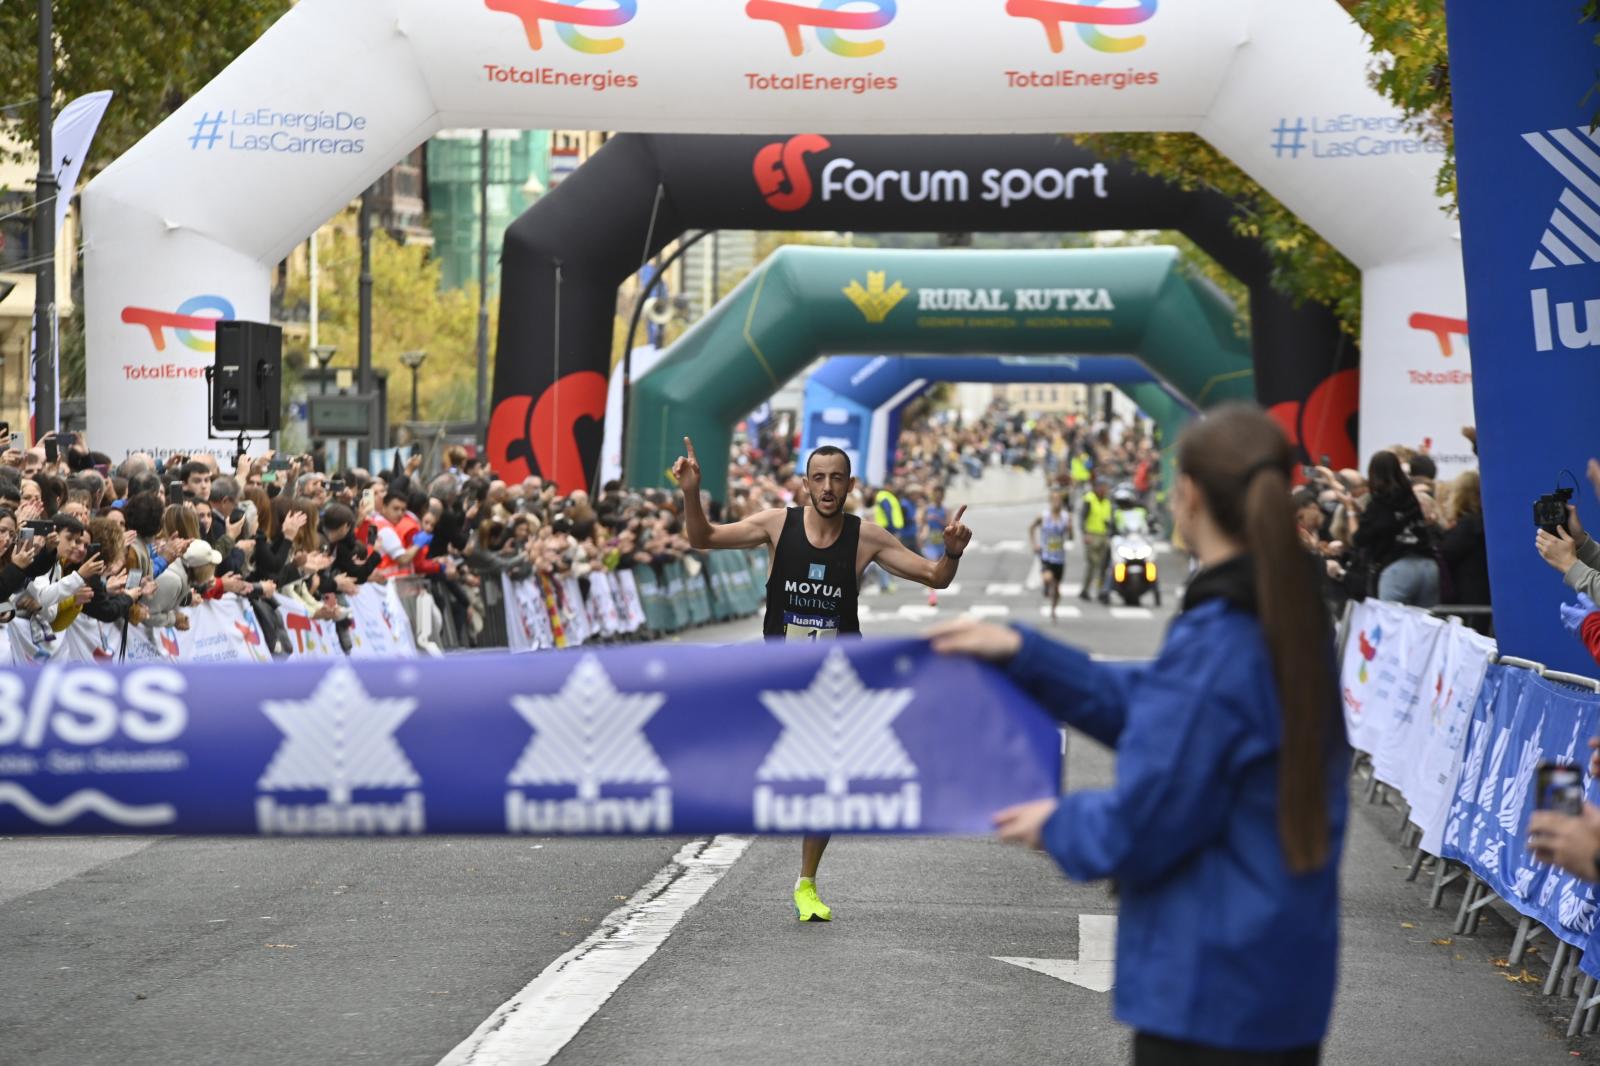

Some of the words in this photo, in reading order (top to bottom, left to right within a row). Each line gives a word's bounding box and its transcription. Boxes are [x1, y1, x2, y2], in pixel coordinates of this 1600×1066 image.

[483, 65, 639, 90] TotalEnergies
[745, 72, 898, 94] TotalEnergies
[1005, 68, 1158, 90] TotalEnergies
[229, 131, 366, 154] LasCarreras
[981, 163, 1108, 208] sport
[917, 287, 1009, 312] RURAL
[1014, 287, 1115, 312] KUTXA
[784, 580, 842, 598] MOYUA
[789, 594, 836, 610] Homes
[792, 615, 823, 627] luanvi
[255, 790, 427, 834] luanvi
[505, 784, 673, 832] luanvi
[752, 780, 922, 830] luanvi
